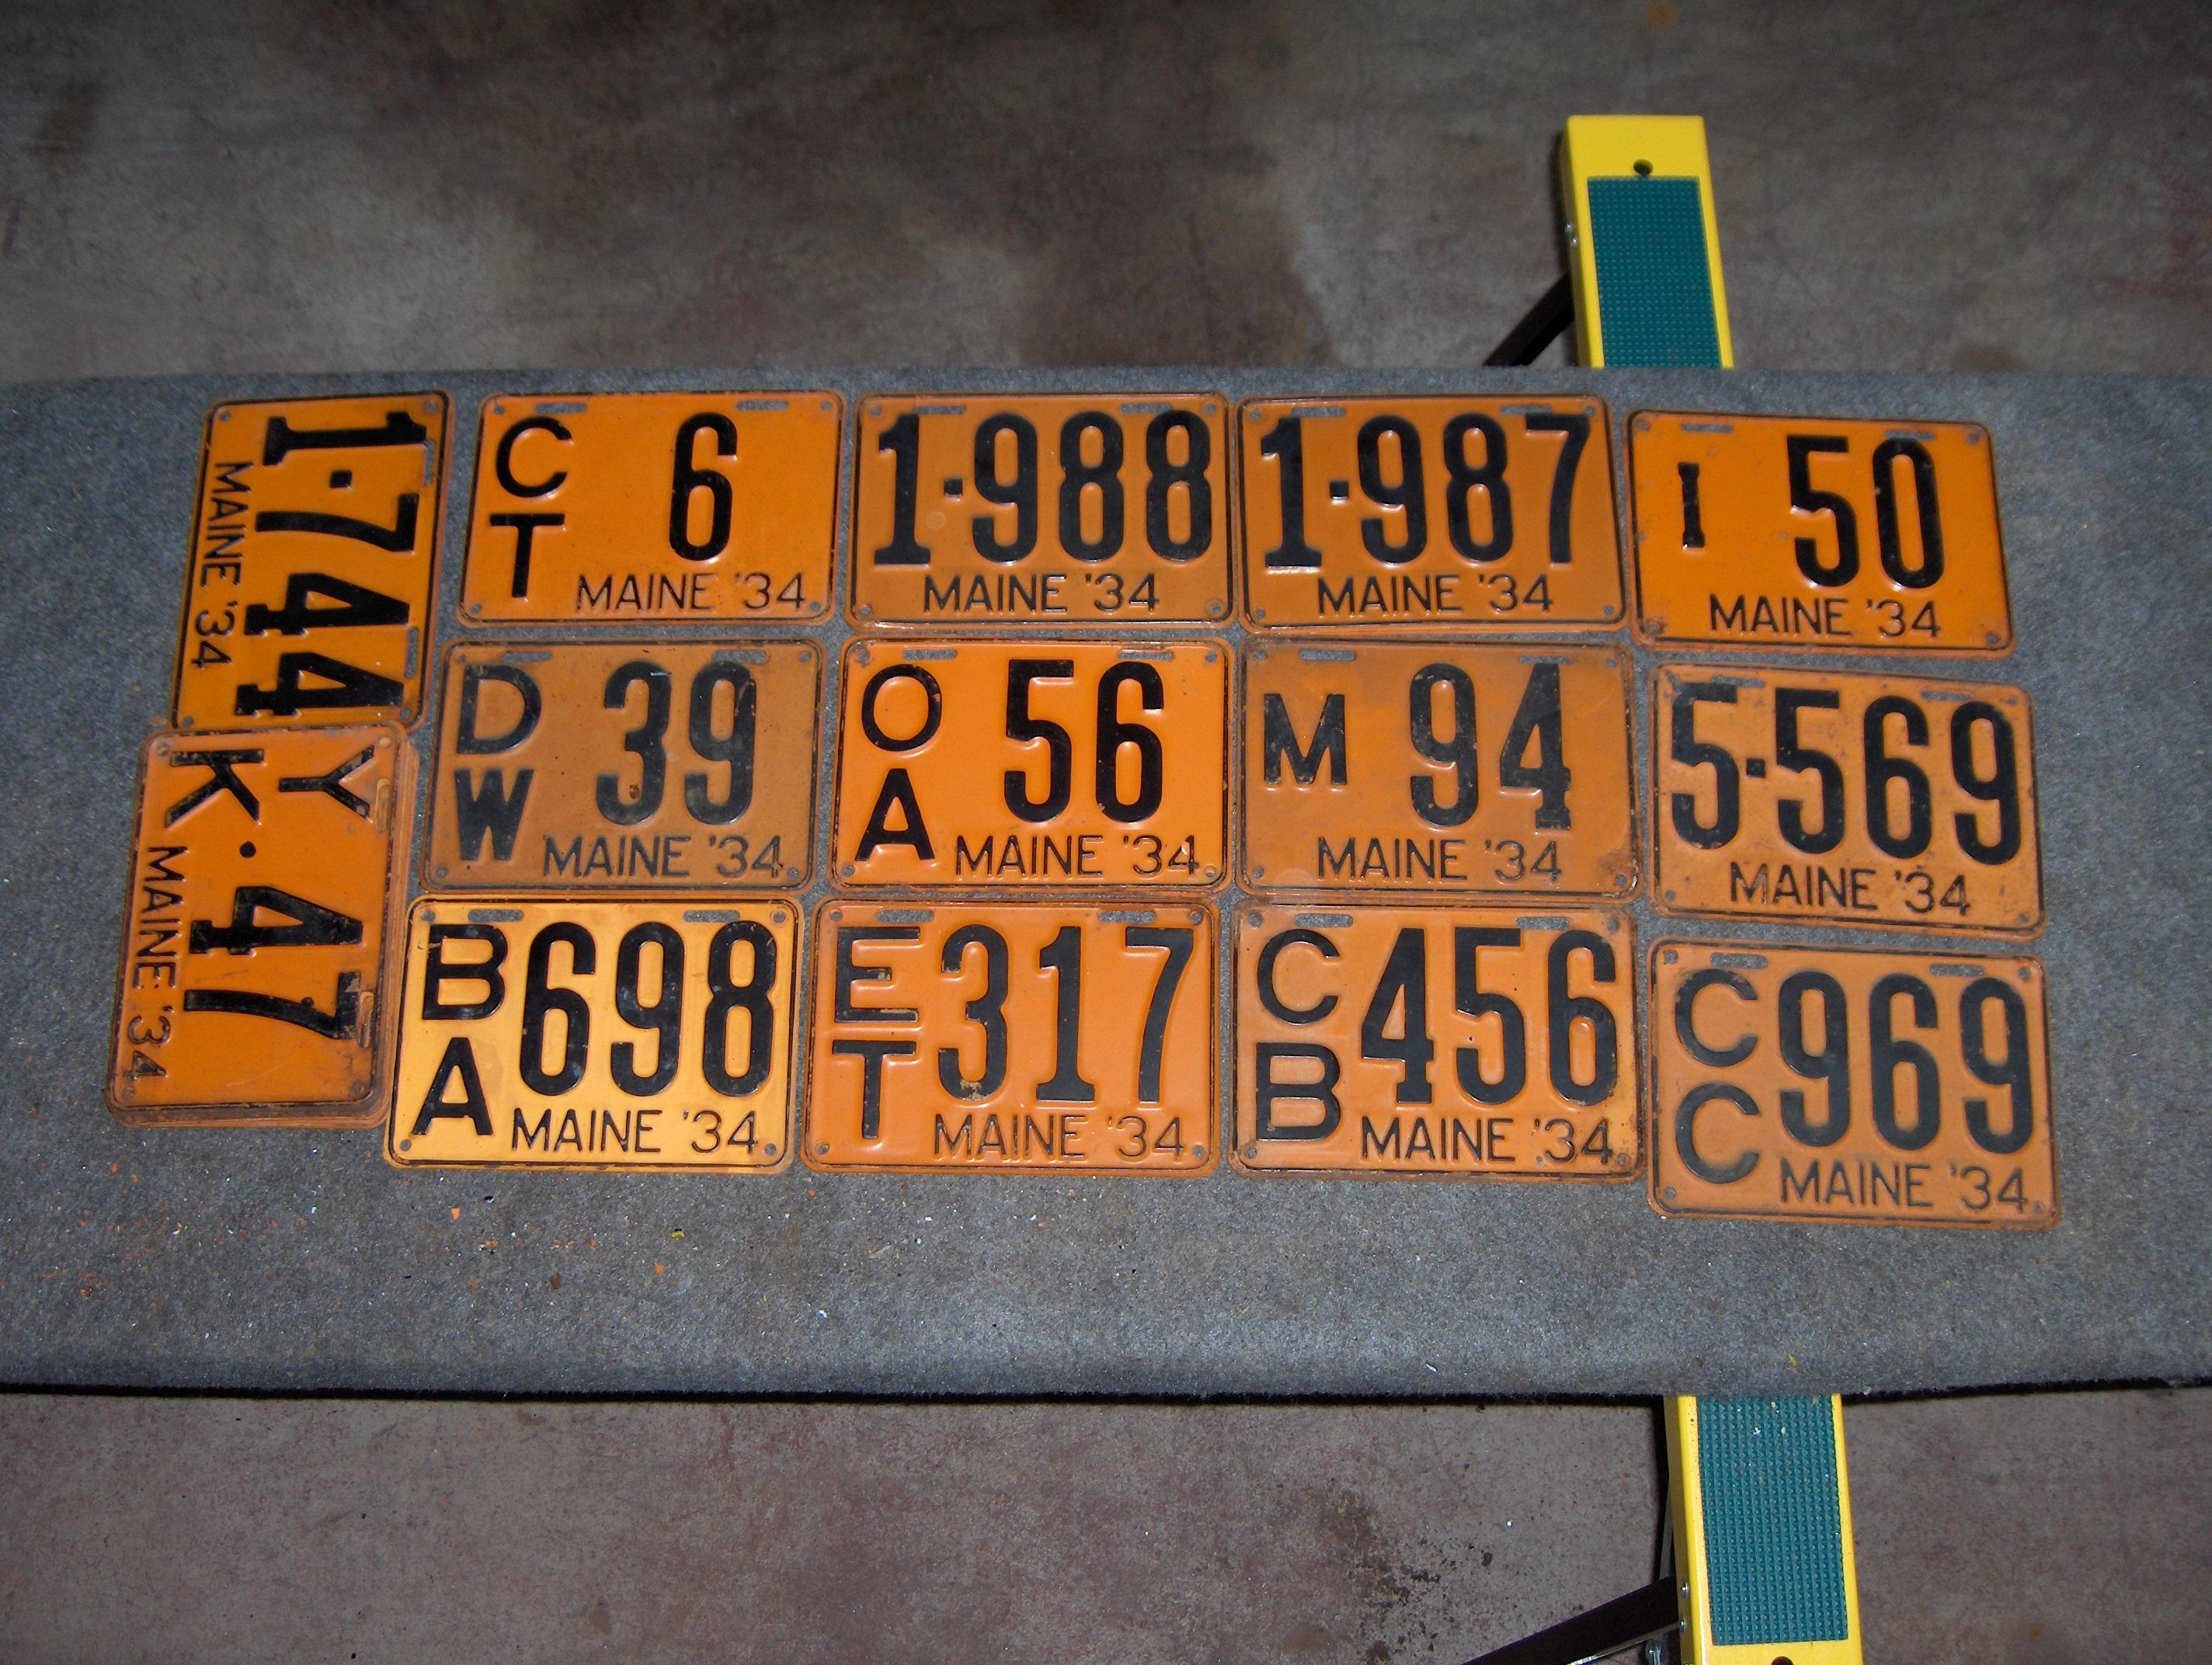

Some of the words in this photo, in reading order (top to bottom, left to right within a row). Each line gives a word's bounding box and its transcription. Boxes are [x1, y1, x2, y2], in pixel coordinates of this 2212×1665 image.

[668, 414, 738, 561] 6
[1786, 435, 1944, 589] 50
[198, 462, 252, 586] MAINE
[578, 575, 716, 611] MAINE
[733, 573, 805, 611] '34
[924, 577, 1068, 613] MAINE
[1084, 574, 1160, 611] '34
[1318, 576, 1463, 614] MAINE
[1477, 574, 1553, 613] '34
[1709, 594, 1848, 636] MAINE
[1865, 599, 1940, 638] '34
[190, 599, 235, 669] '34
[595, 662, 756, 826] 39
[1003, 659, 1163, 822] 56
[1263, 693, 1345, 786] M
[1408, 662, 1571, 829] 94
[542, 838, 691, 878] MAINE
[708, 836, 783, 875] '34
[955, 837, 1104, 876] MAINE
[1122, 835, 1198, 875] '34
[1318, 840, 1466, 880] MAINE
[1484, 839, 1561, 880] '34
[1730, 863, 1876, 910] MAINE
[1895, 870, 1970, 912] '34
[133, 846, 189, 991] MAINE
[126, 1006, 171, 1081] '34
[518, 921, 773, 1098] 698
[937, 923, 1195, 1104] 317
[1360, 928, 1616, 1106] 456
[1777, 970, 2033, 1154] 969
[511, 1111, 662, 1155] MAINE
[683, 1111, 757, 1154] '34
[934, 1116, 1087, 1160] MAINE
[1106, 1114, 1184, 1157] '34
[1362, 1118, 1518, 1162] MAINE
[1534, 1118, 1612, 1163] '34
[1780, 1158, 1940, 1208] MAINE
[1949, 1163, 2028, 1210] '34
